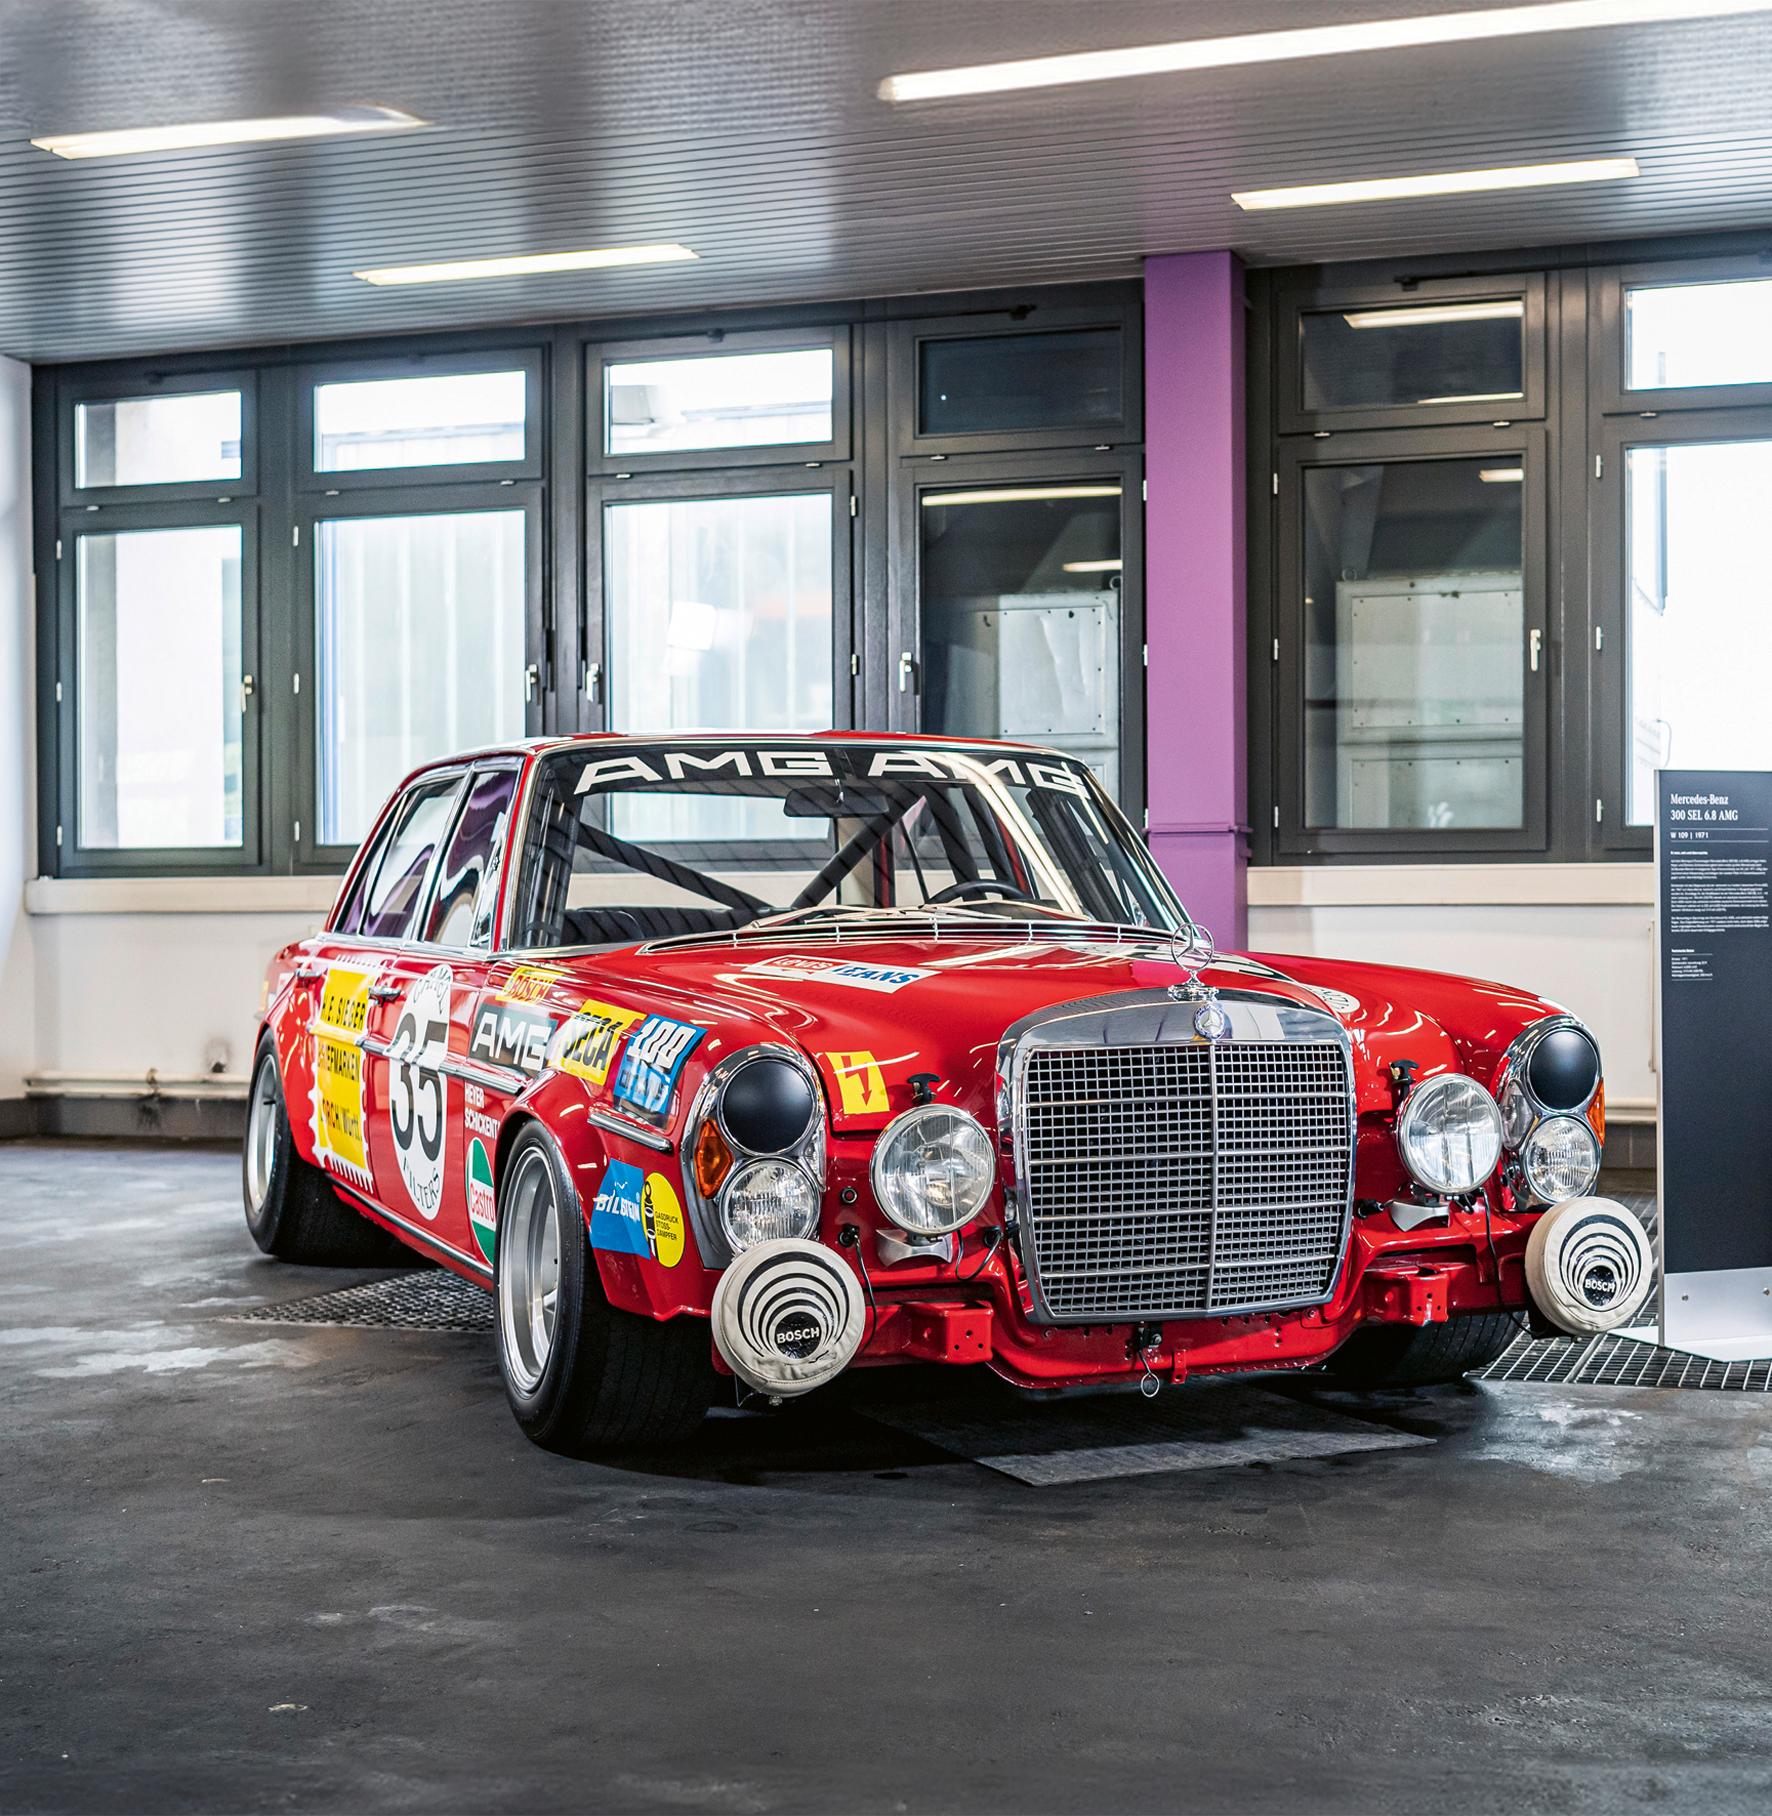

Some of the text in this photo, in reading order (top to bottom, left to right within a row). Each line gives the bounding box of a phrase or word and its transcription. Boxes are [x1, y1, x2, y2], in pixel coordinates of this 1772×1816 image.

[573, 751, 1092, 800] AMG AMG
[1670, 793, 1729, 805] Mercedes-Benz
[1670, 809, 1739, 821] 300 SEL 6.8 AMG
[1670, 831, 1677, 839] W
[1678, 831, 1689, 839] 109
[1695, 831, 1709, 839] 1971
[471, 1011, 552, 1071] AMG
[388, 1012, 448, 1162] 35
[1584, 1278, 1616, 1293] BOSCH
[776, 1326, 821, 1344] BOSCH
